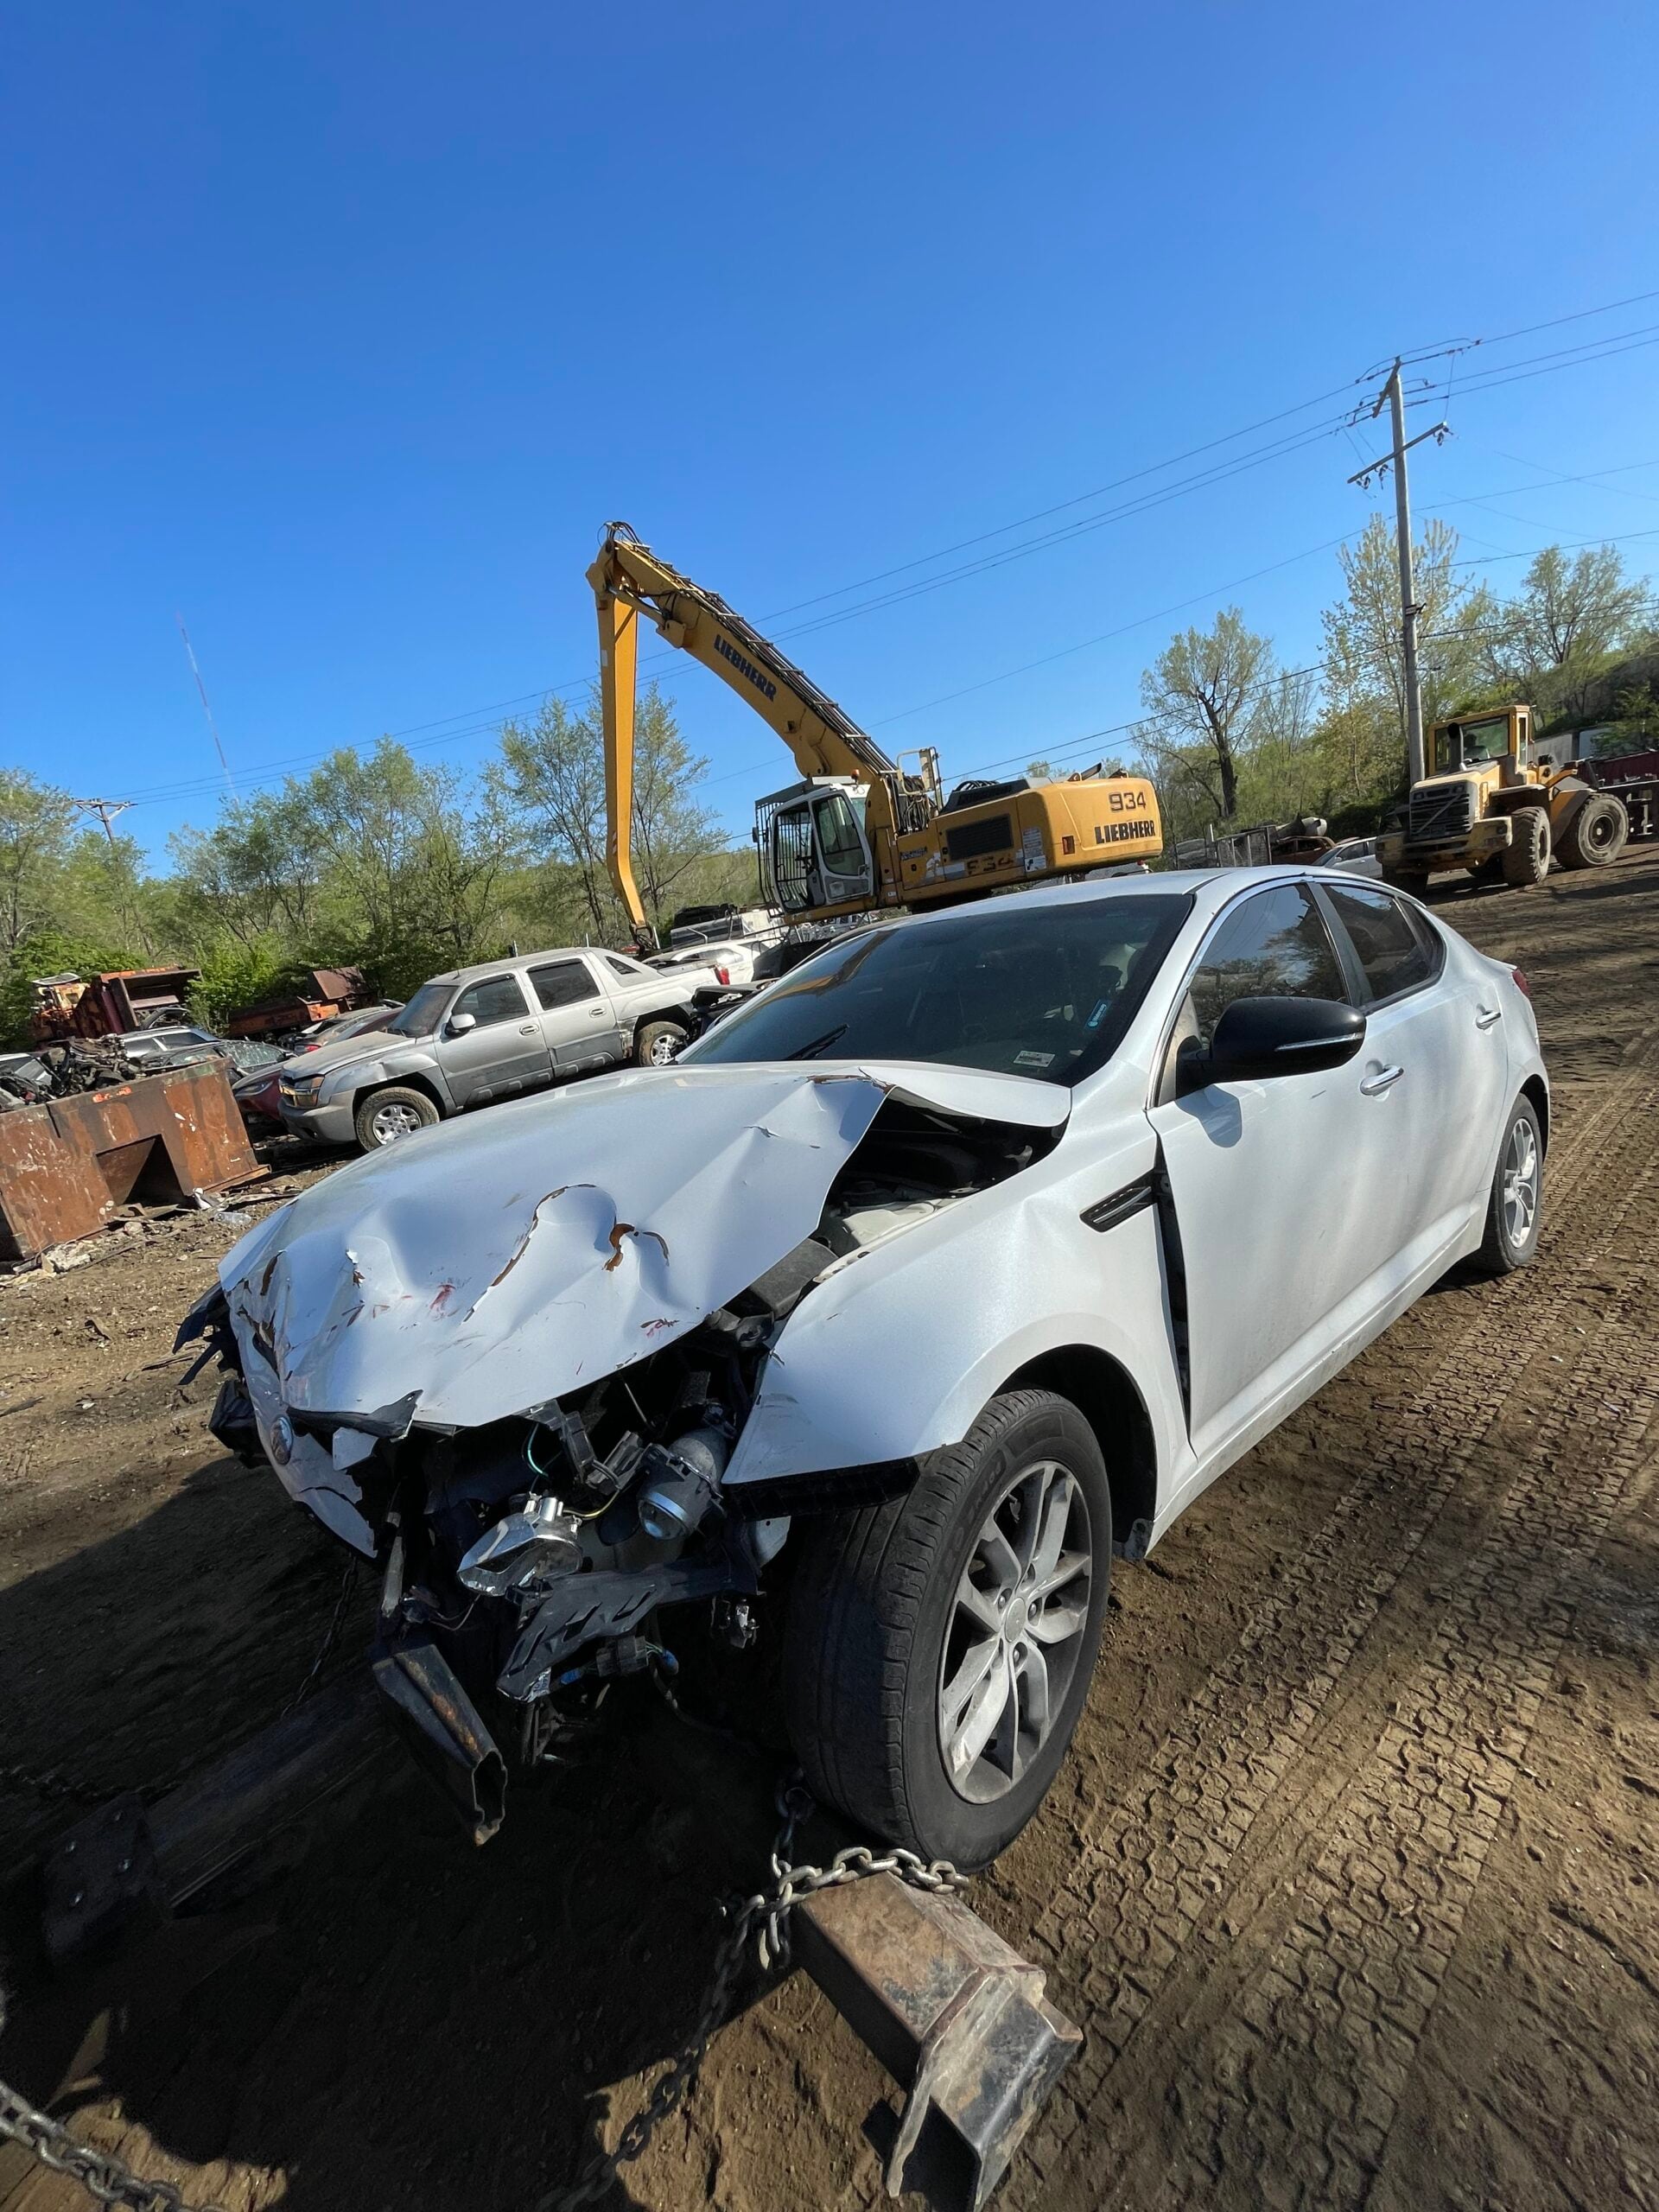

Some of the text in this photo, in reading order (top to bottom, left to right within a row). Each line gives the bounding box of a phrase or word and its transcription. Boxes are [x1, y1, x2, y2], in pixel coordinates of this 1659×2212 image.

[715, 634, 776, 702] LIEBHERR
[1109, 791, 1146, 810] 934
[1095, 820, 1155, 844] LIEBHERR
